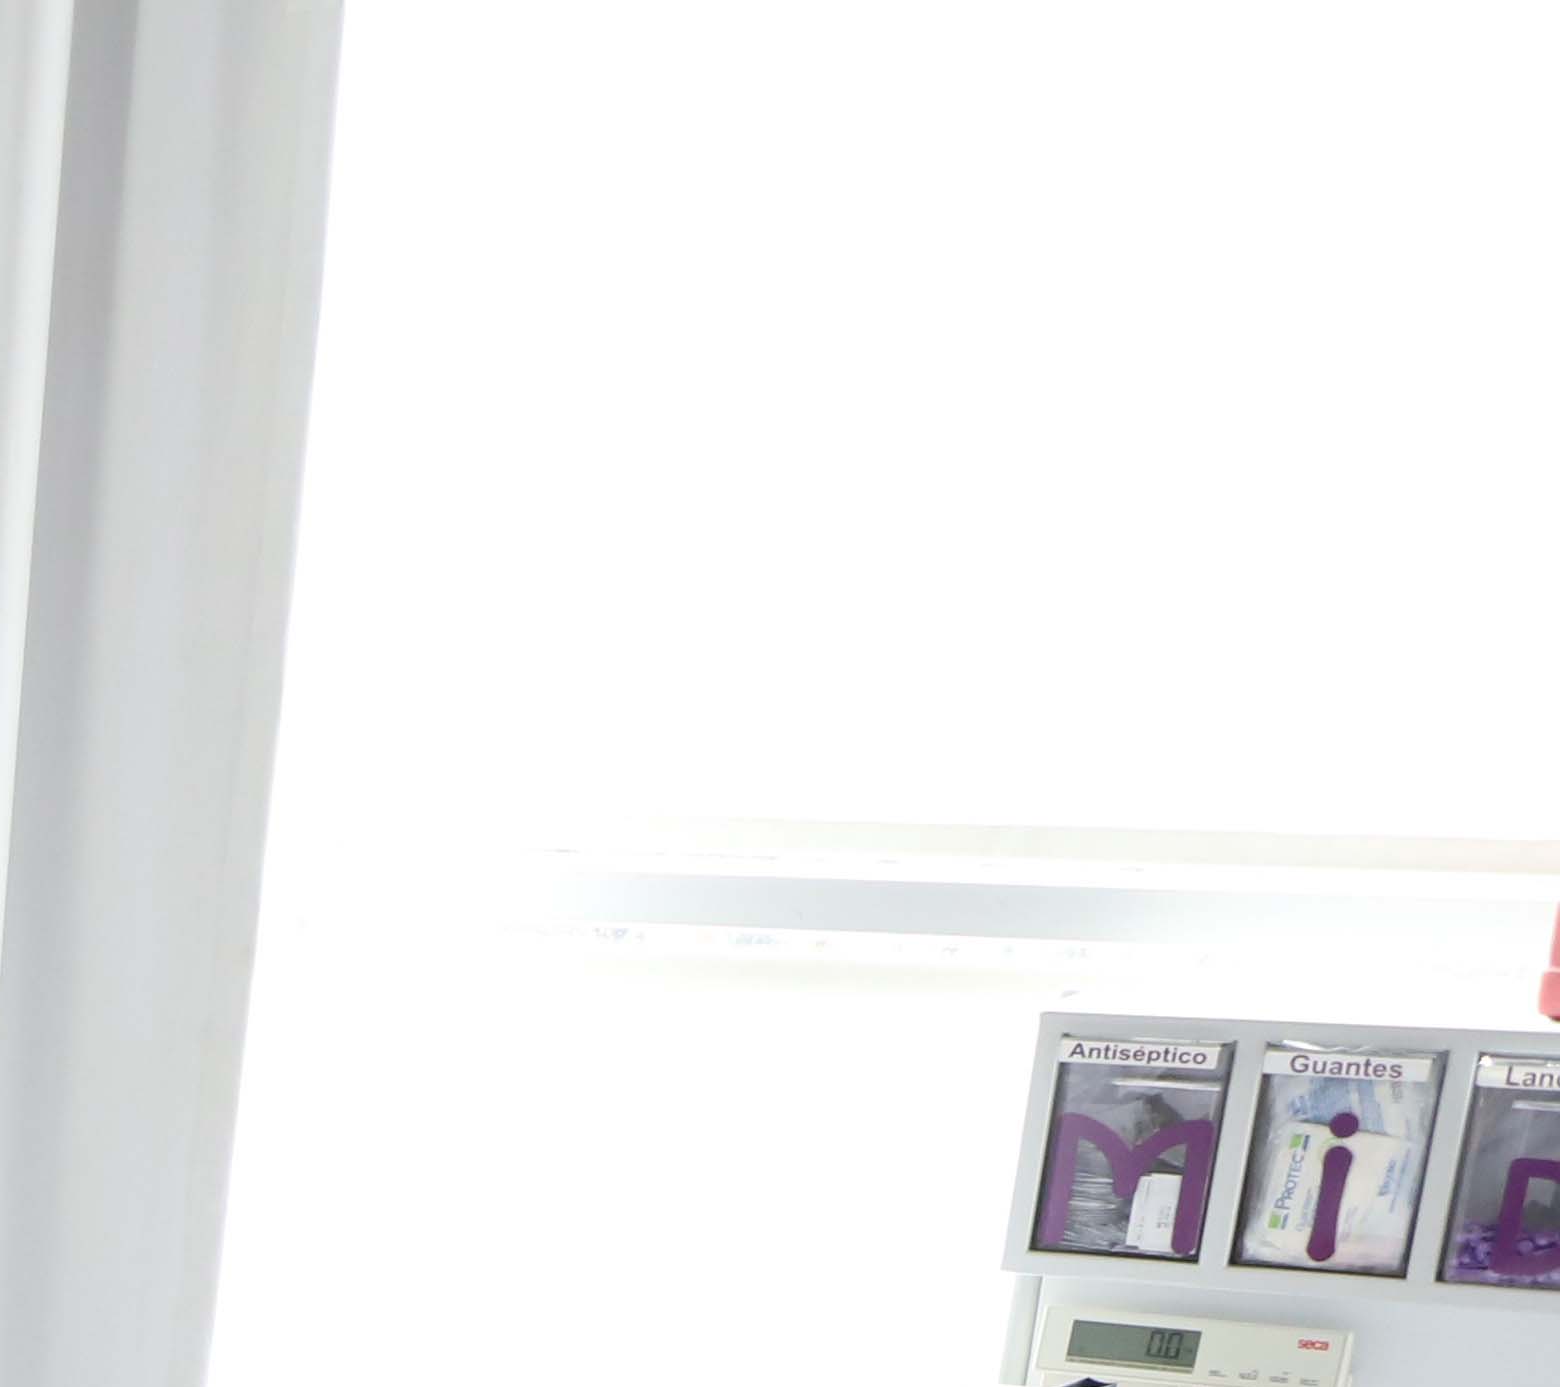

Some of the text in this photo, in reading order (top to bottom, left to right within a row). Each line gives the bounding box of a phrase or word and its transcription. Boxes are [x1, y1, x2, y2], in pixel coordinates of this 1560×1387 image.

[1068, 1043, 1208, 1065] Antiséptico
[1290, 1054, 1404, 1079] Guantes
[1505, 1065, 1560, 1088] Lan
[1298, 1339, 1330, 1352] seca
